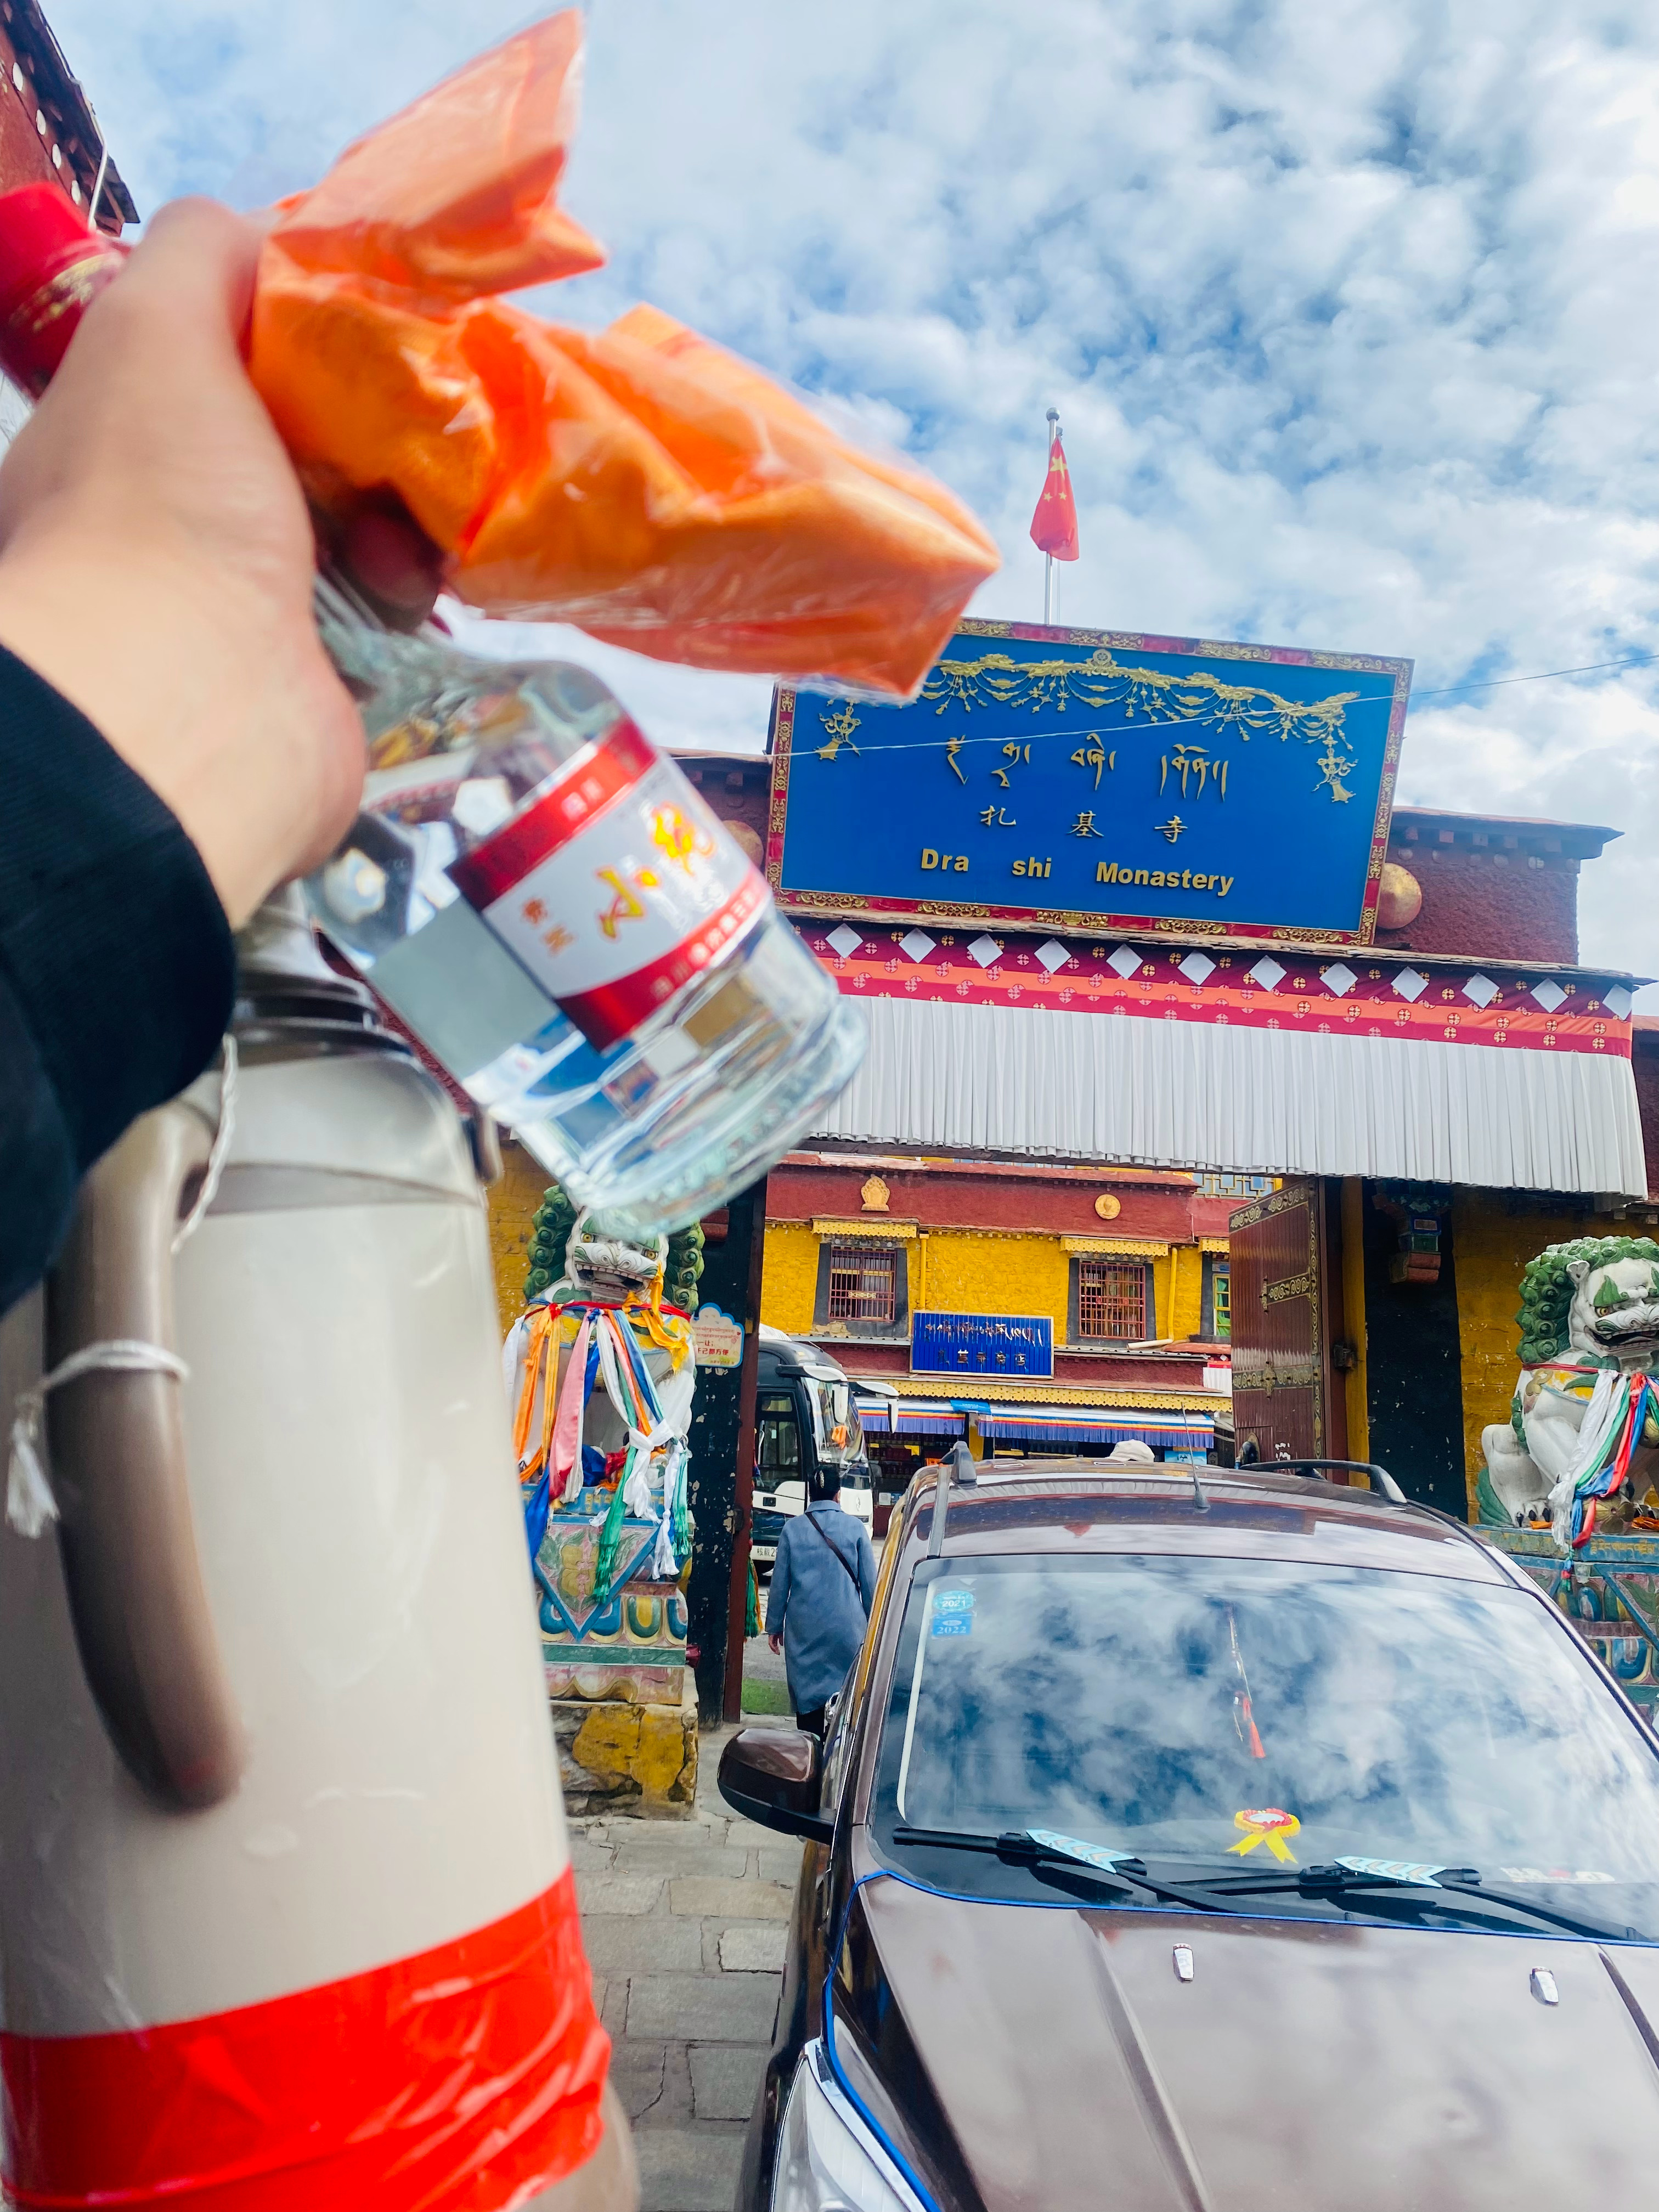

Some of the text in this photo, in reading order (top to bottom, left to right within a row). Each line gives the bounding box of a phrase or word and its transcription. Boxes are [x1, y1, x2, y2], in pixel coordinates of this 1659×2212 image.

[980, 804, 1188, 843] 扎基寺
[921, 848, 1234, 897] Dra shi Monastery
[936, 1626, 967, 1634] 2022
